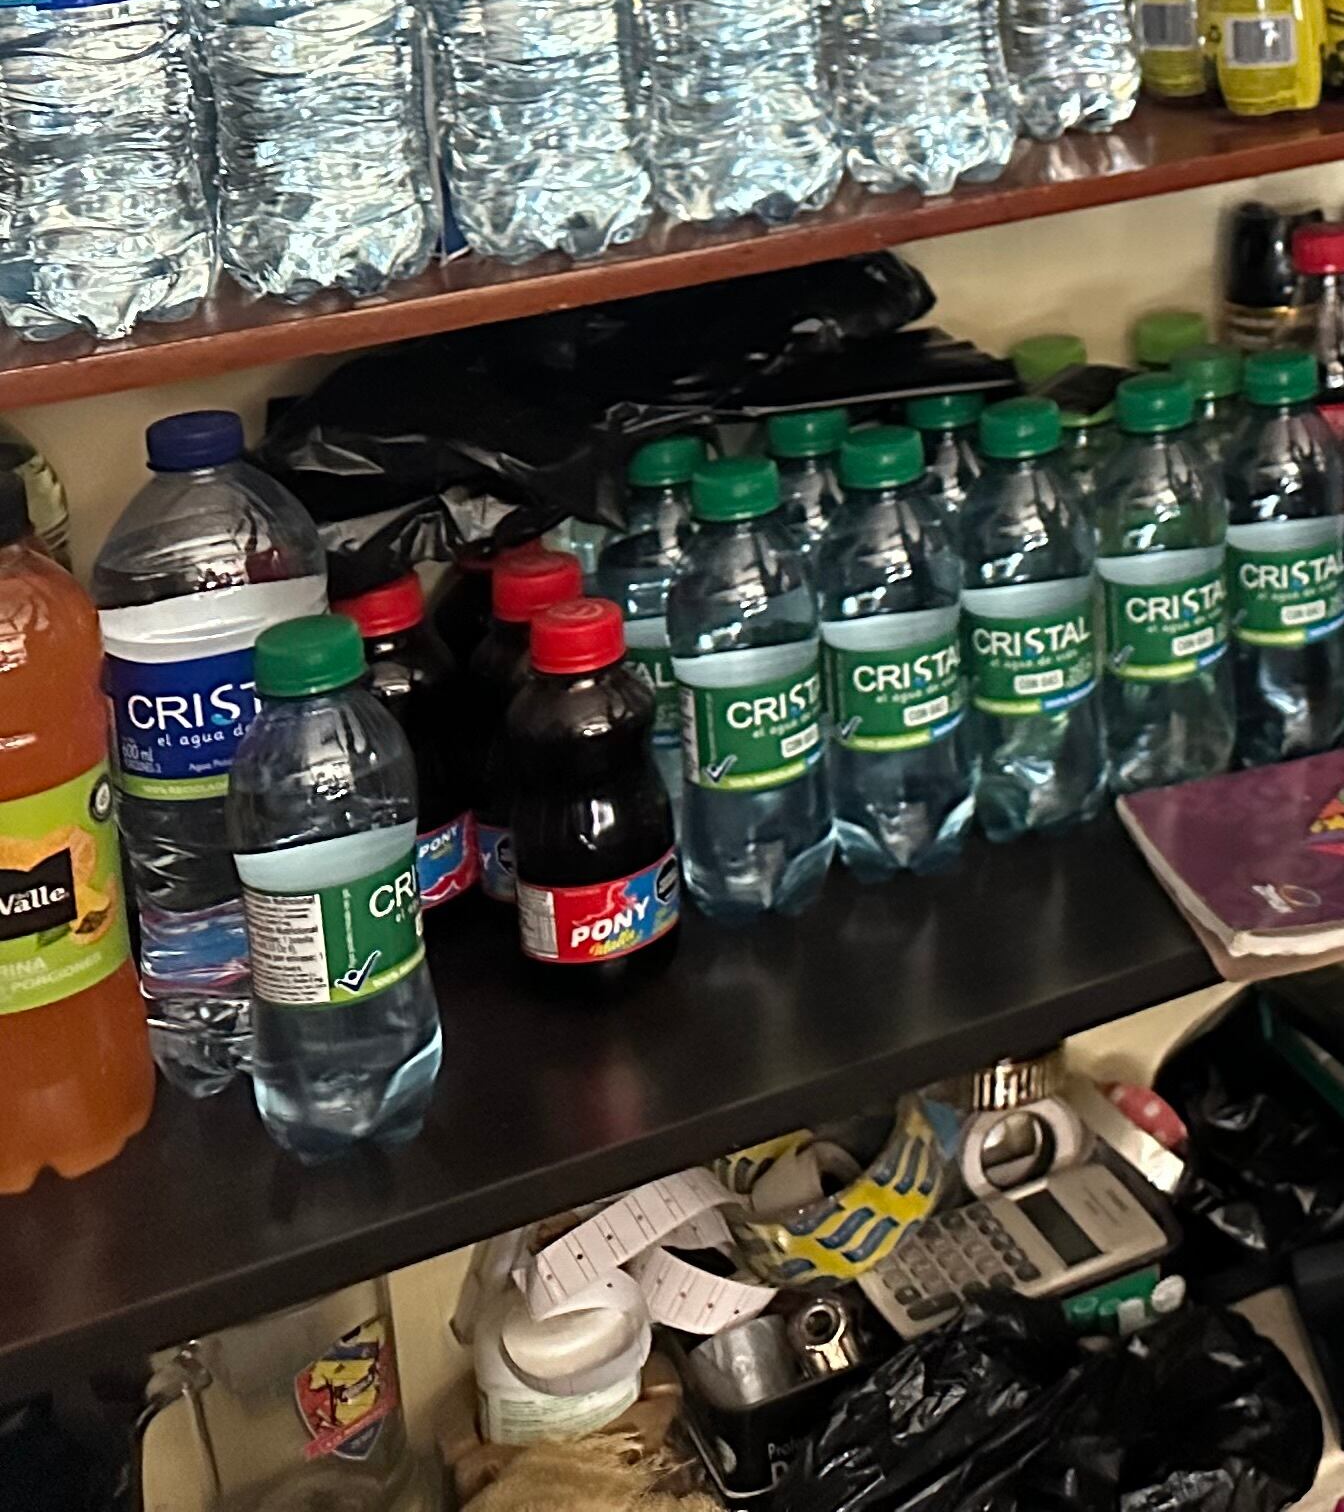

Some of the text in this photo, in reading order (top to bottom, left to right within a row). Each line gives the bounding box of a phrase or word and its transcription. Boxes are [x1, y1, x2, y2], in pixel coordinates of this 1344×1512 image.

[1125, 579, 1227, 624] CRISTA
[973, 616, 1091, 658] CRISTAL
[852, 645, 961, 693] CRISTA
[726, 674, 821, 730] CRIST
[157, 733, 171, 747] el
[180, 731, 225, 749] agua
[419, 825, 459, 858] PONY
[571, 895, 650, 949] PONY
